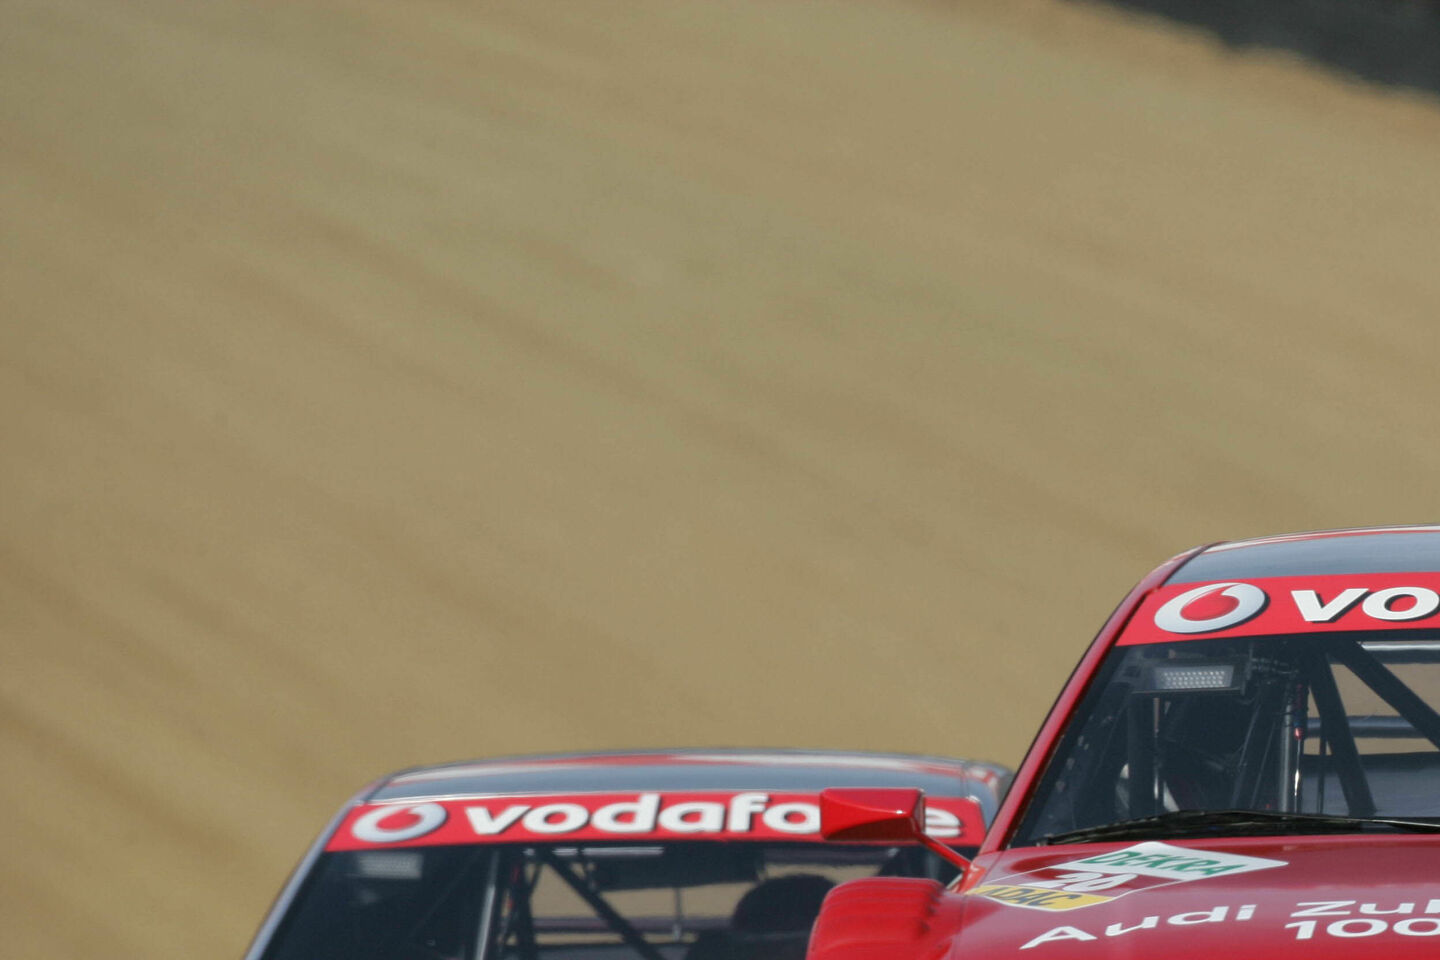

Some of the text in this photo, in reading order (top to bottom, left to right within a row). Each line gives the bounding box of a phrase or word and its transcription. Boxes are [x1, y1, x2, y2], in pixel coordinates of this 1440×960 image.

[464, 793, 962, 838] vodafoe
[1078, 851, 1246, 876] DEKRA
[985, 886, 1083, 907] ADAC
[1019, 904, 1257, 950] Audi
